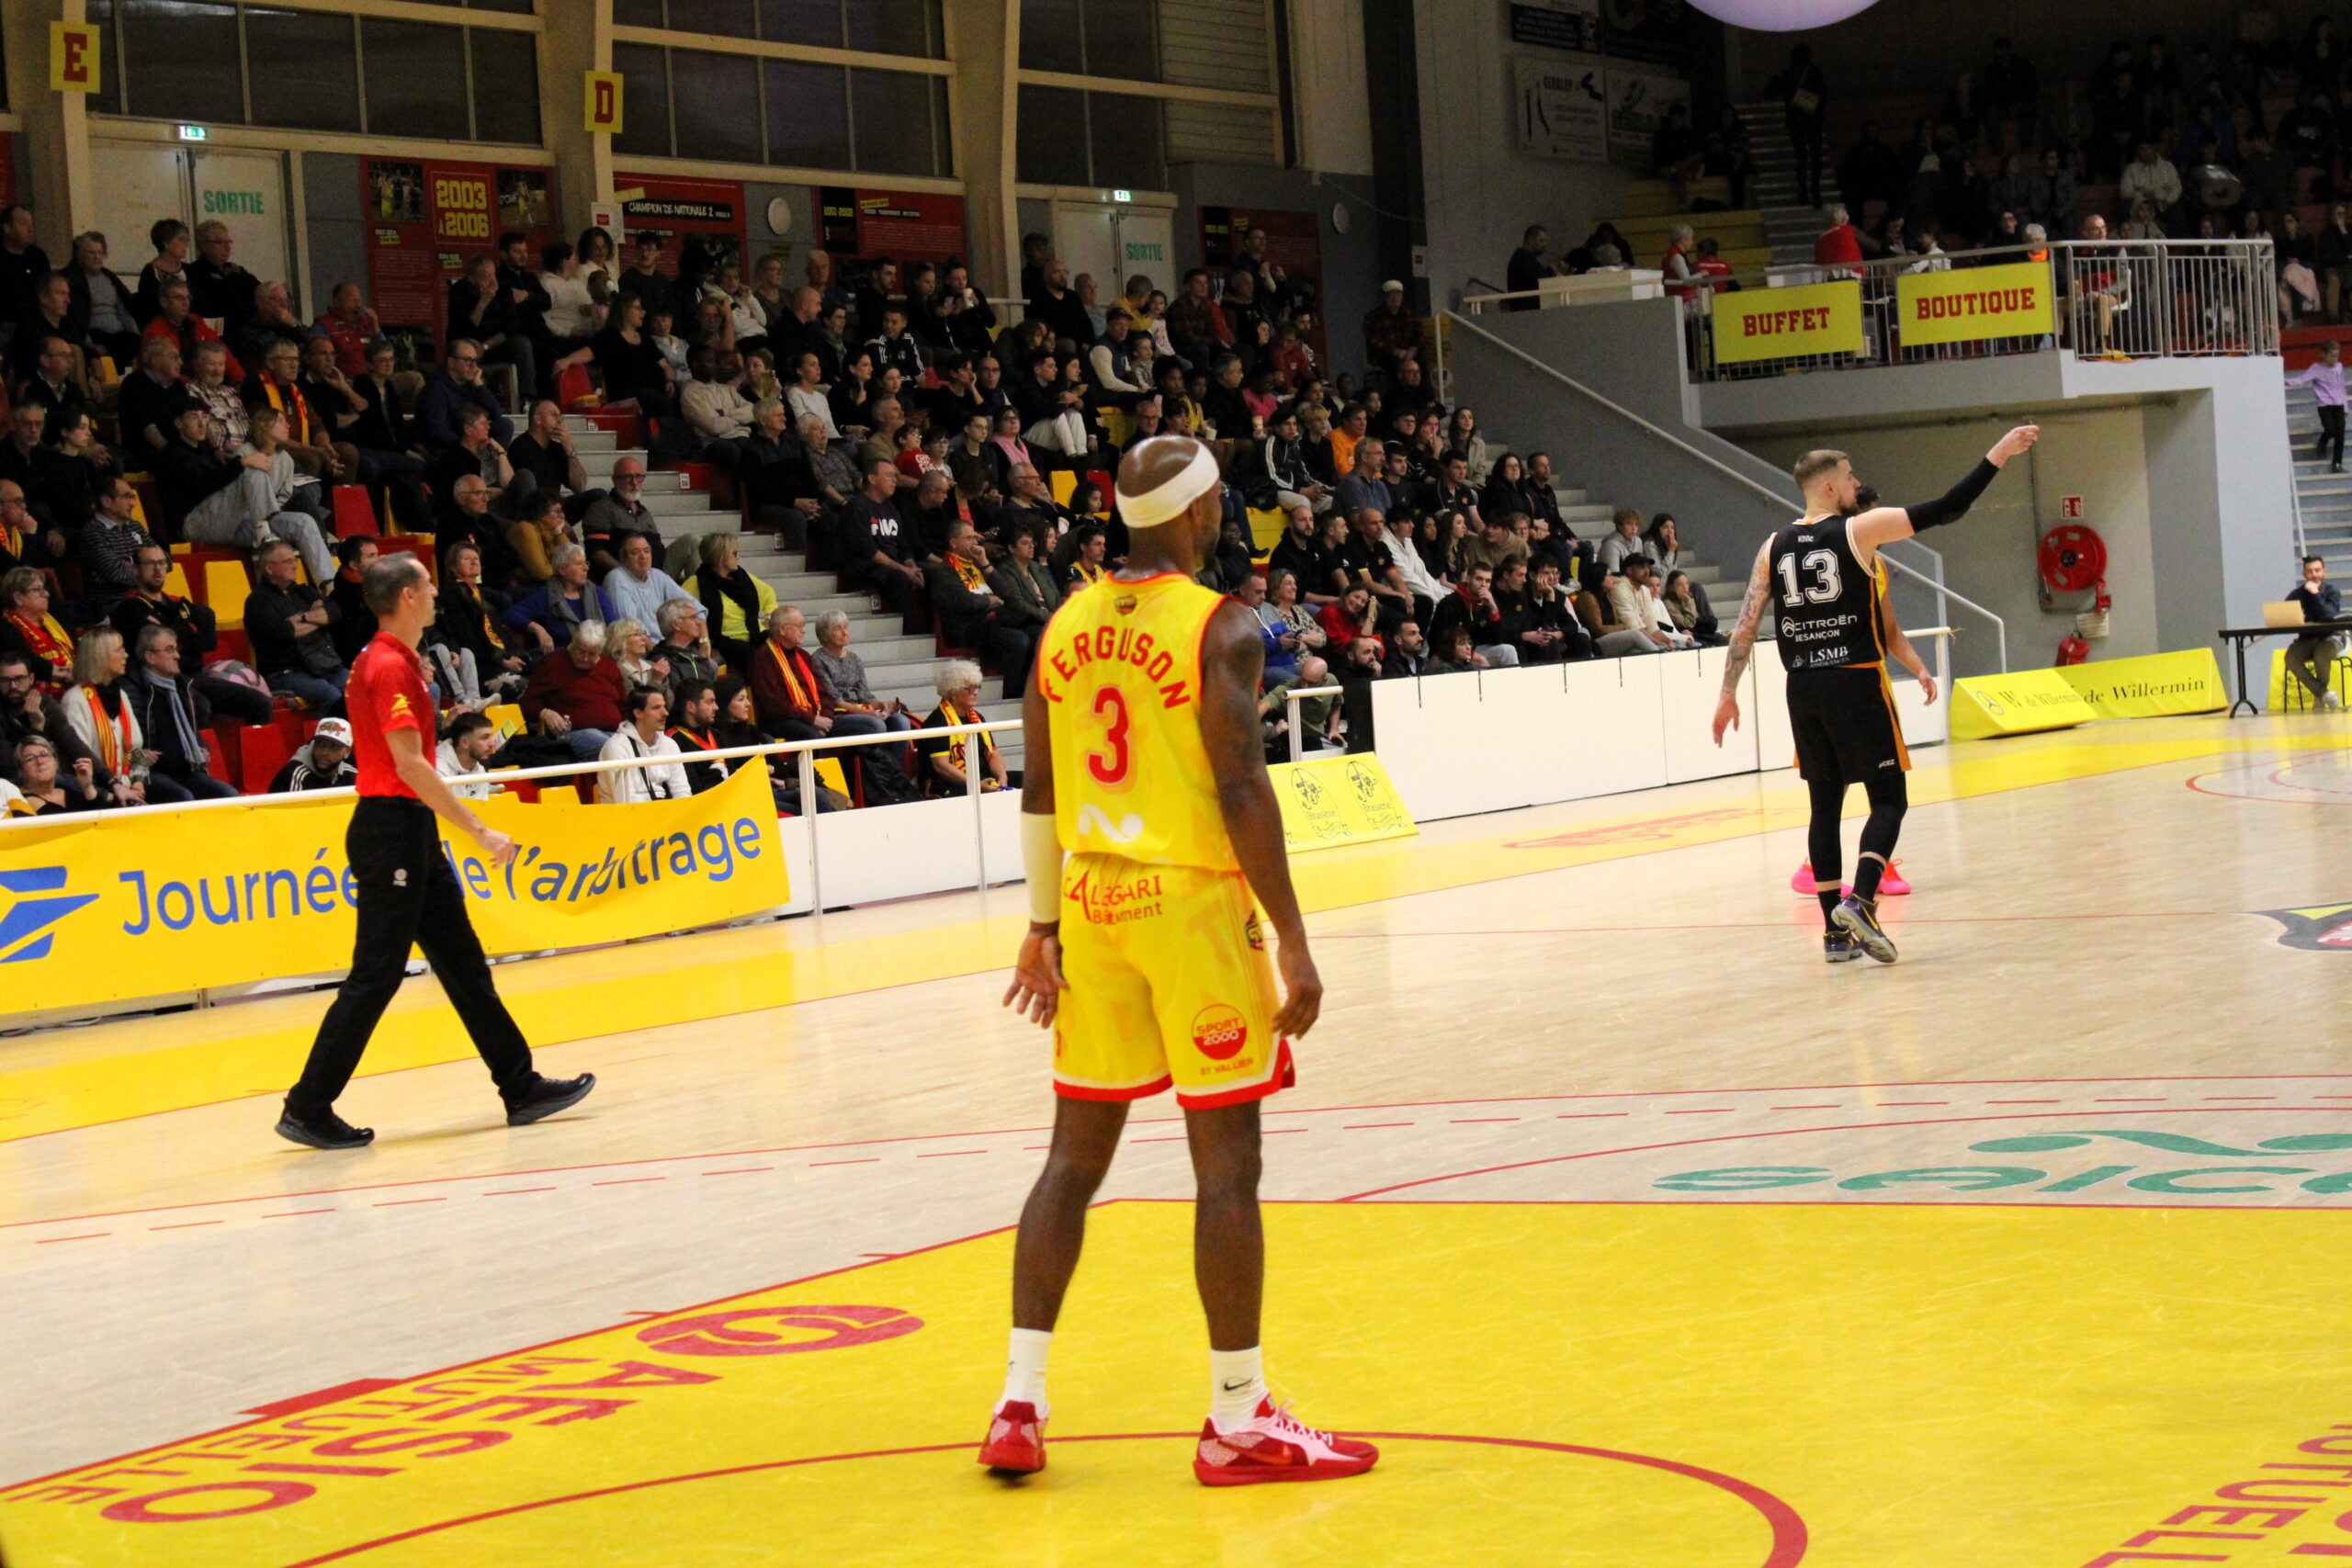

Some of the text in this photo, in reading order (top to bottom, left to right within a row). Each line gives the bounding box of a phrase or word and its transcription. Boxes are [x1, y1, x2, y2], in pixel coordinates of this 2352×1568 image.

[62, 32, 87, 83] E
[594, 80, 615, 124] D
[203, 190, 264, 215] SORTIE
[435, 180, 487, 209] 2003
[628, 202, 662, 214] CHAMPION
[662, 204, 673, 215] DE
[674, 205, 707, 217] NATIONALE
[708, 207, 714, 218] 2
[445, 211, 490, 238] 2006
[1125, 242, 1163, 262] SORTIE
[1916, 287, 2036, 321] BOUTIQUE
[1743, 306, 1830, 337] BUFFET
[1777, 548, 1843, 608] 13
[1045, 625, 1192, 710] FERGUSON
[1810, 646, 1849, 663] LSMB
[2084, 677, 2204, 705] de Willermin
[1088, 683, 1130, 785] 3
[1196, 1017, 1240, 1034] SPORT
[1204, 1030, 1239, 1046] 2000
[1214, 1057, 1254, 1073] VALLIER
[3, 1357, 601, 1505] MUTUELLE
